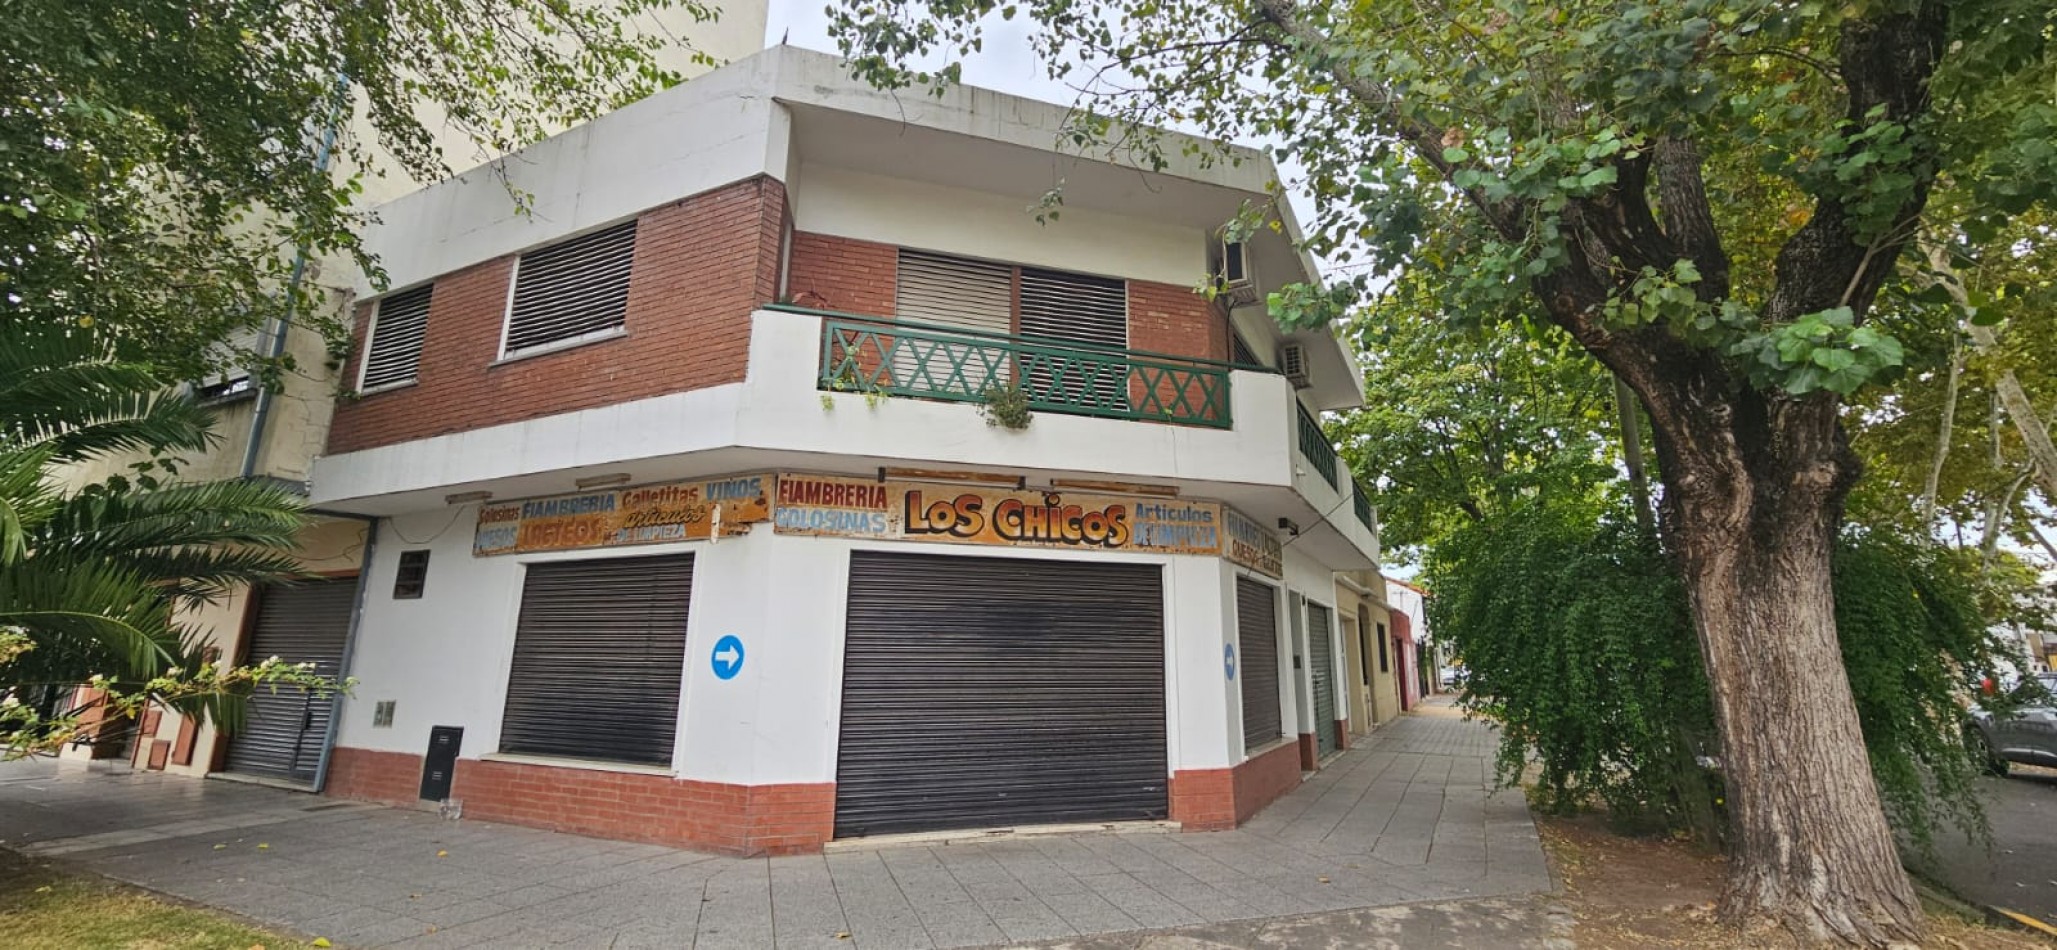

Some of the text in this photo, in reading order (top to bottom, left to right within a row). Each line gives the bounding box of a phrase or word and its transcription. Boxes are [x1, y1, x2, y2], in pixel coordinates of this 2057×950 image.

[522, 493, 615, 519] FIAMBRERIA
[622, 486, 698, 509] Galletitas
[706, 478, 761, 500] VINOS
[779, 479, 887, 509] FIAMBRERIA
[776, 506, 887, 533] GOLOSINAS
